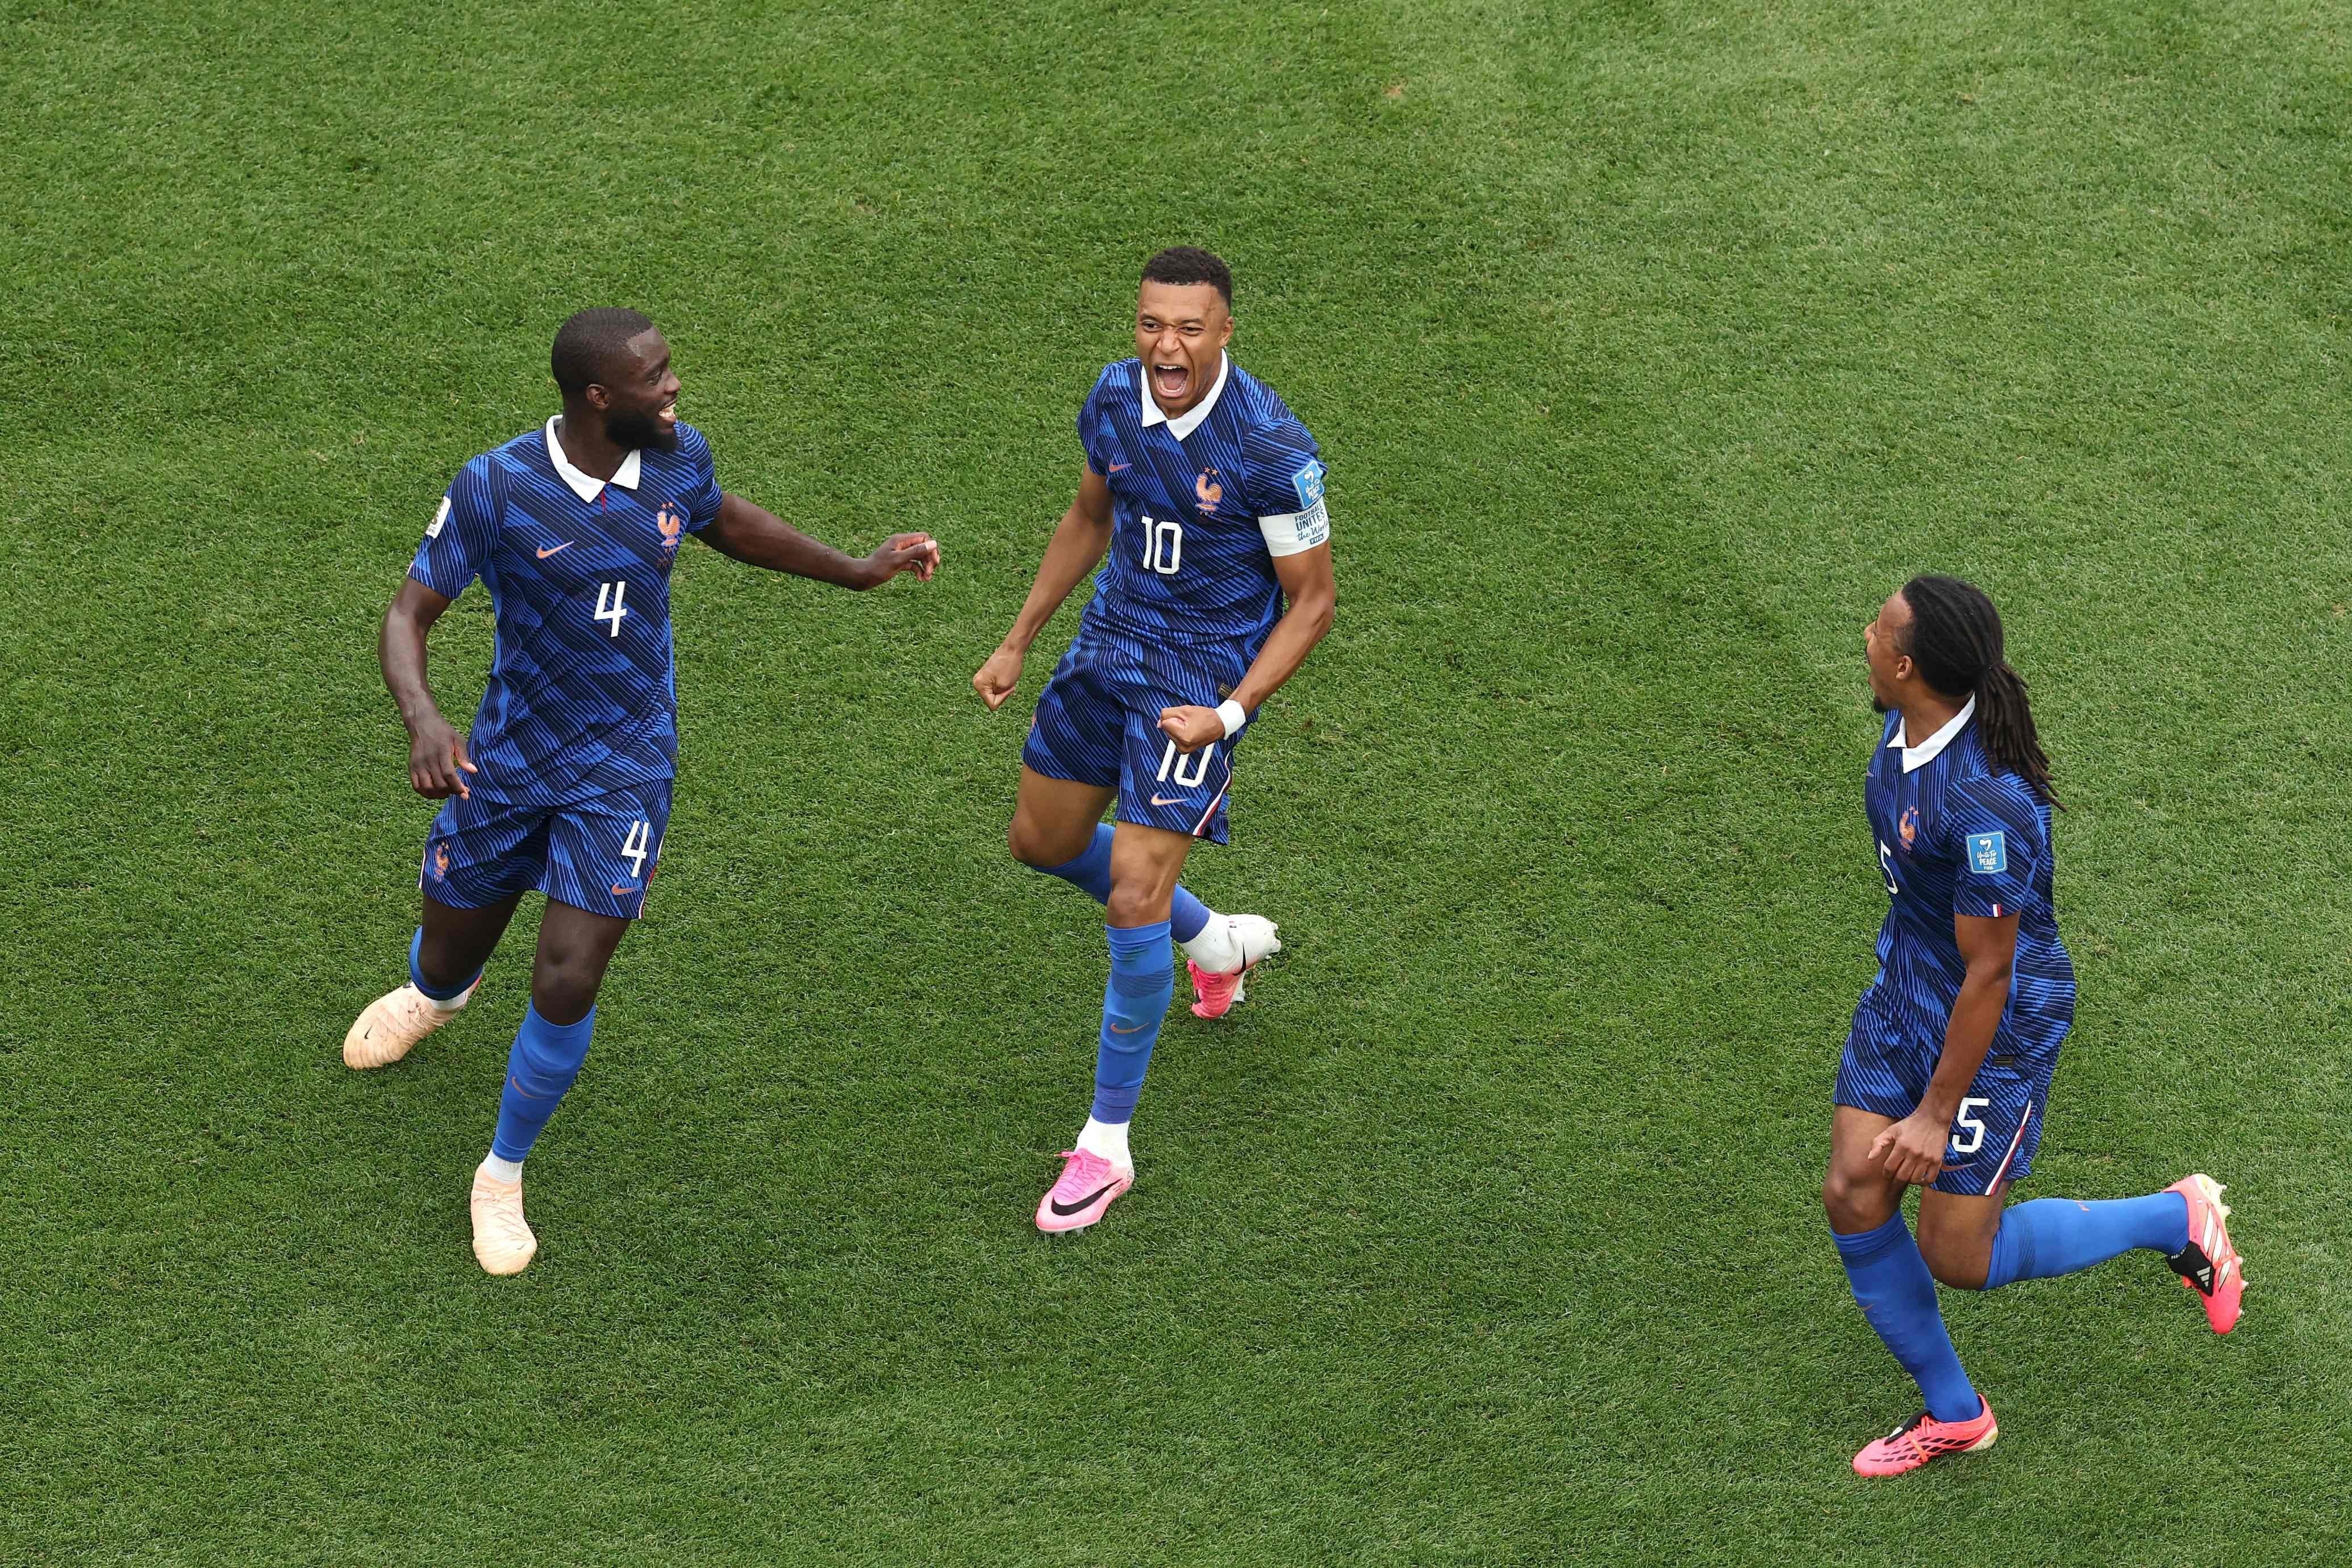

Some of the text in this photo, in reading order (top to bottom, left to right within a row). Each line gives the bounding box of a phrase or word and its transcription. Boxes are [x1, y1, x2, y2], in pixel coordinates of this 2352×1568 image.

[1295, 502, 1322, 522] FOOTBALL
[1308, 485, 1320, 499] PEACE
[1141, 515, 1183, 575] 10
[1296, 508, 1325, 531] UNITES
[1298, 531, 1310, 541] the
[594, 581, 627, 638] 4
[1156, 739, 1215, 788] 10
[621, 820, 649, 878] 4
[1880, 840, 1899, 894] 5
[1951, 1097, 1990, 1153] 5
